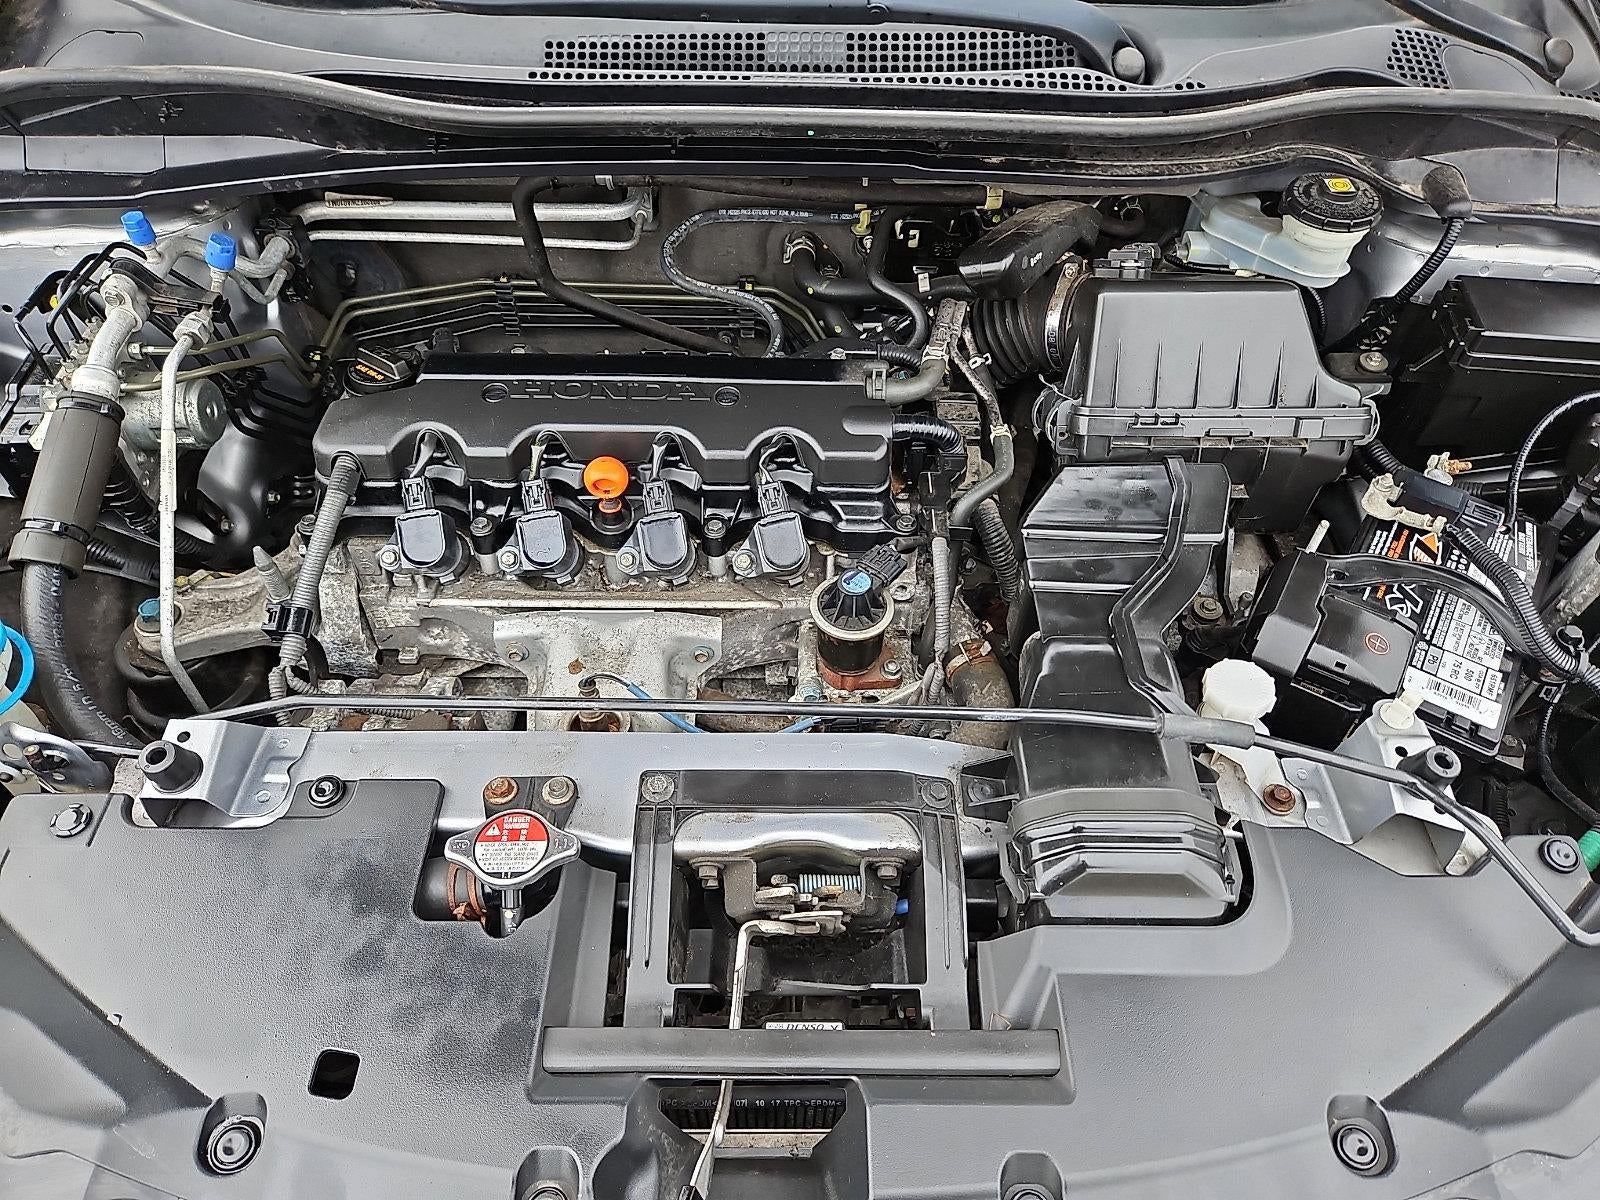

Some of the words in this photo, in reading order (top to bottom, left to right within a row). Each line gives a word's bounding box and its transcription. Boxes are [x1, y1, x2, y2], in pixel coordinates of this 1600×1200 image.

[509, 381, 712, 402] HONDA
[1427, 653, 1439, 665] Pb
[1449, 668, 1460, 680] RC
